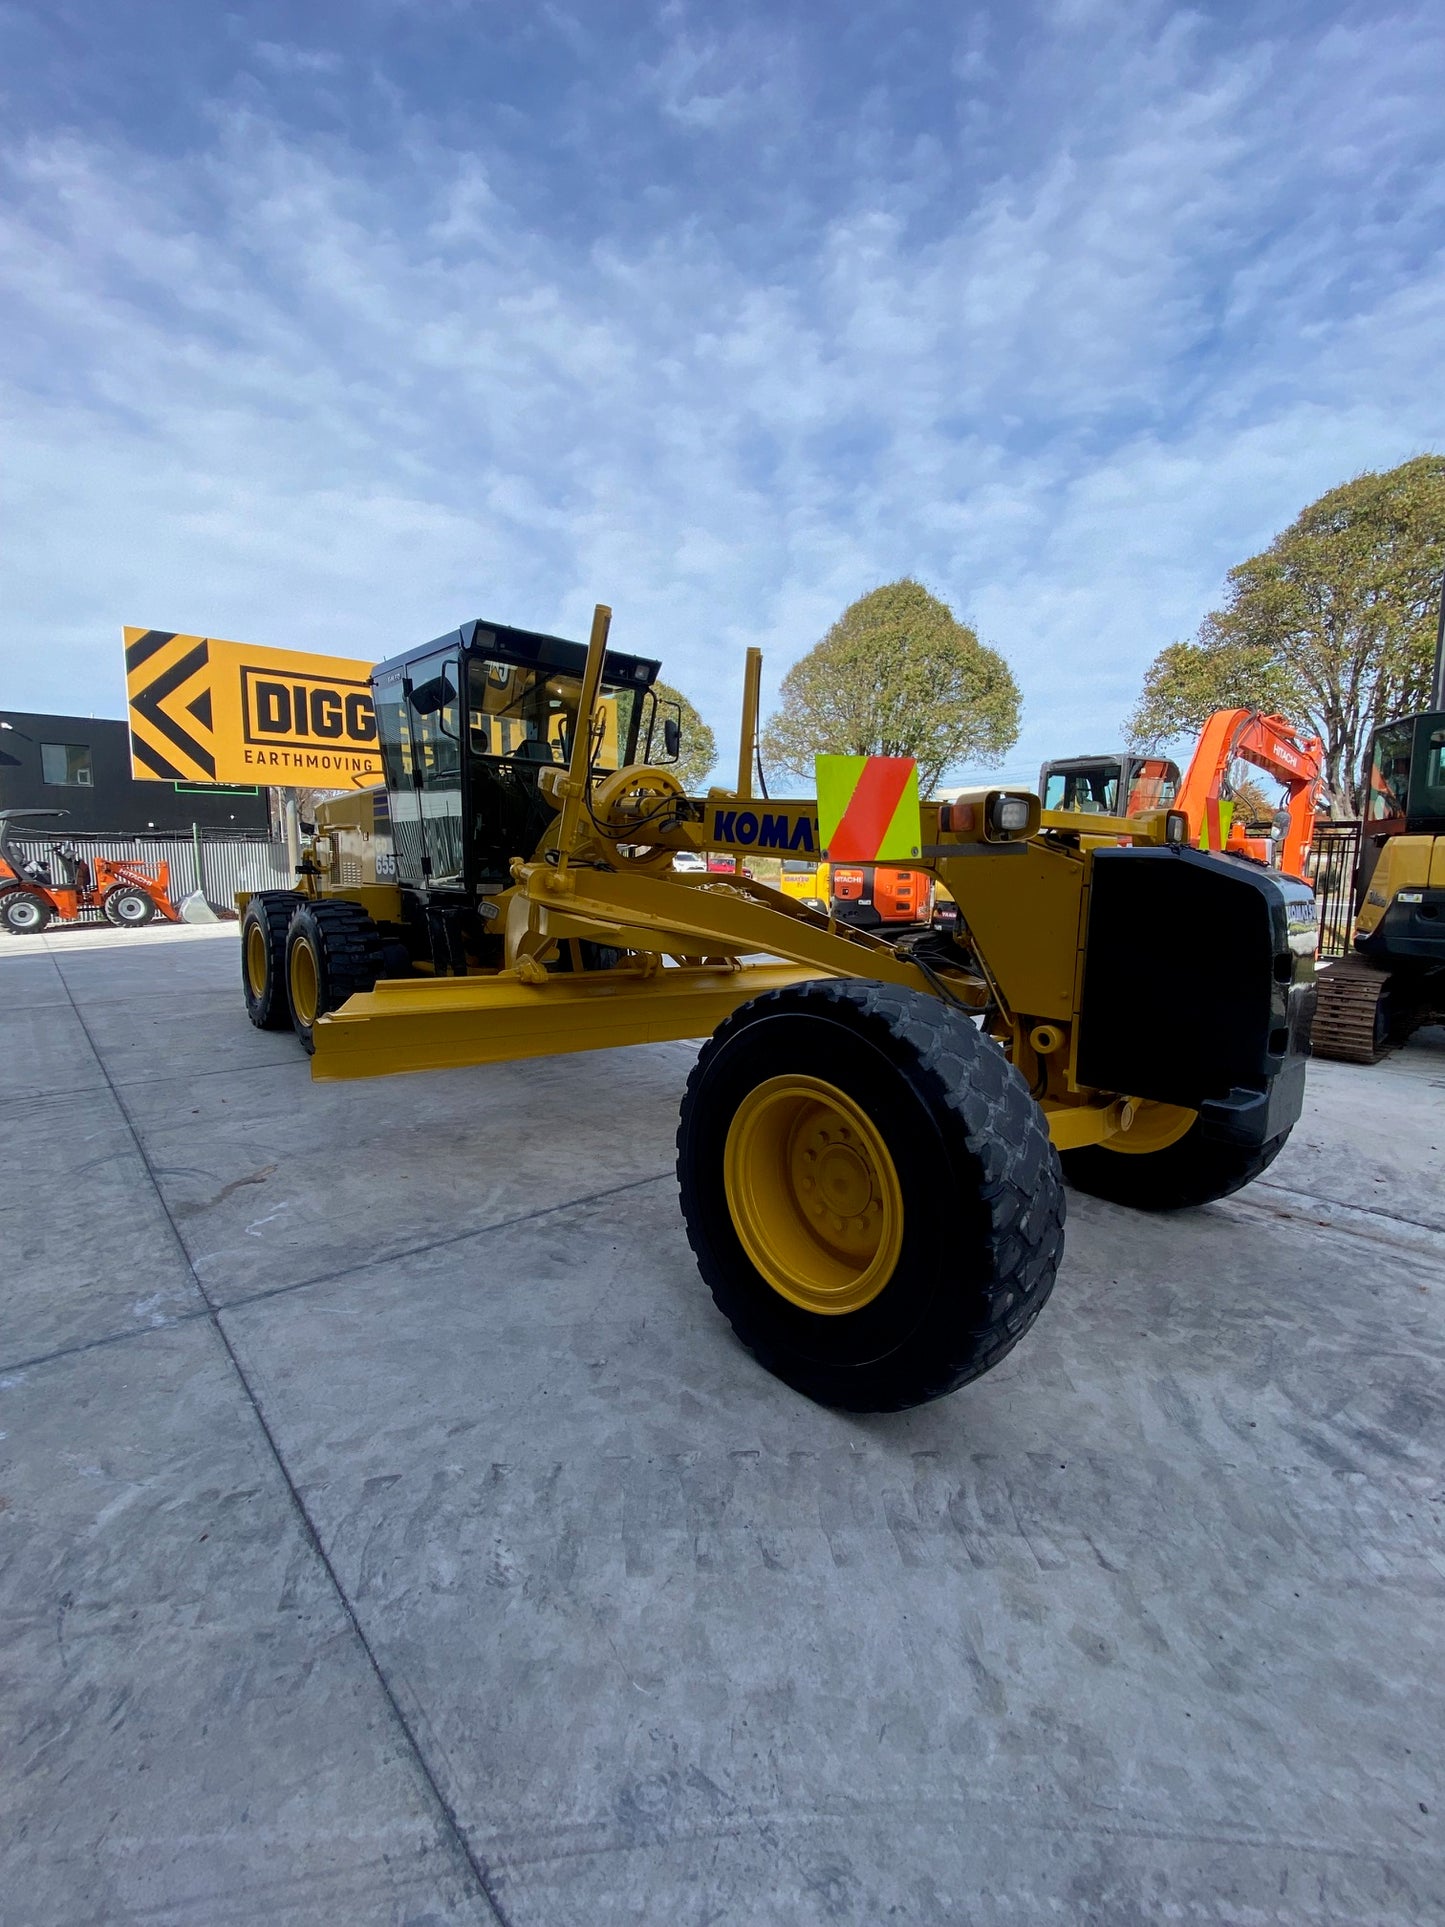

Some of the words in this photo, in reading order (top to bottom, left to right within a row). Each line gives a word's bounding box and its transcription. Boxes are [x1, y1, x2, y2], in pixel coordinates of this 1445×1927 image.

[244, 749, 373, 772] EARTHMOVING
[1272, 743, 1298, 768] HITACHI
[713, 810, 819, 853] KOMA
[375, 855, 396, 875] 655
[119, 868, 153, 887] HITACHI
[834, 876, 863, 884] HITACHI
